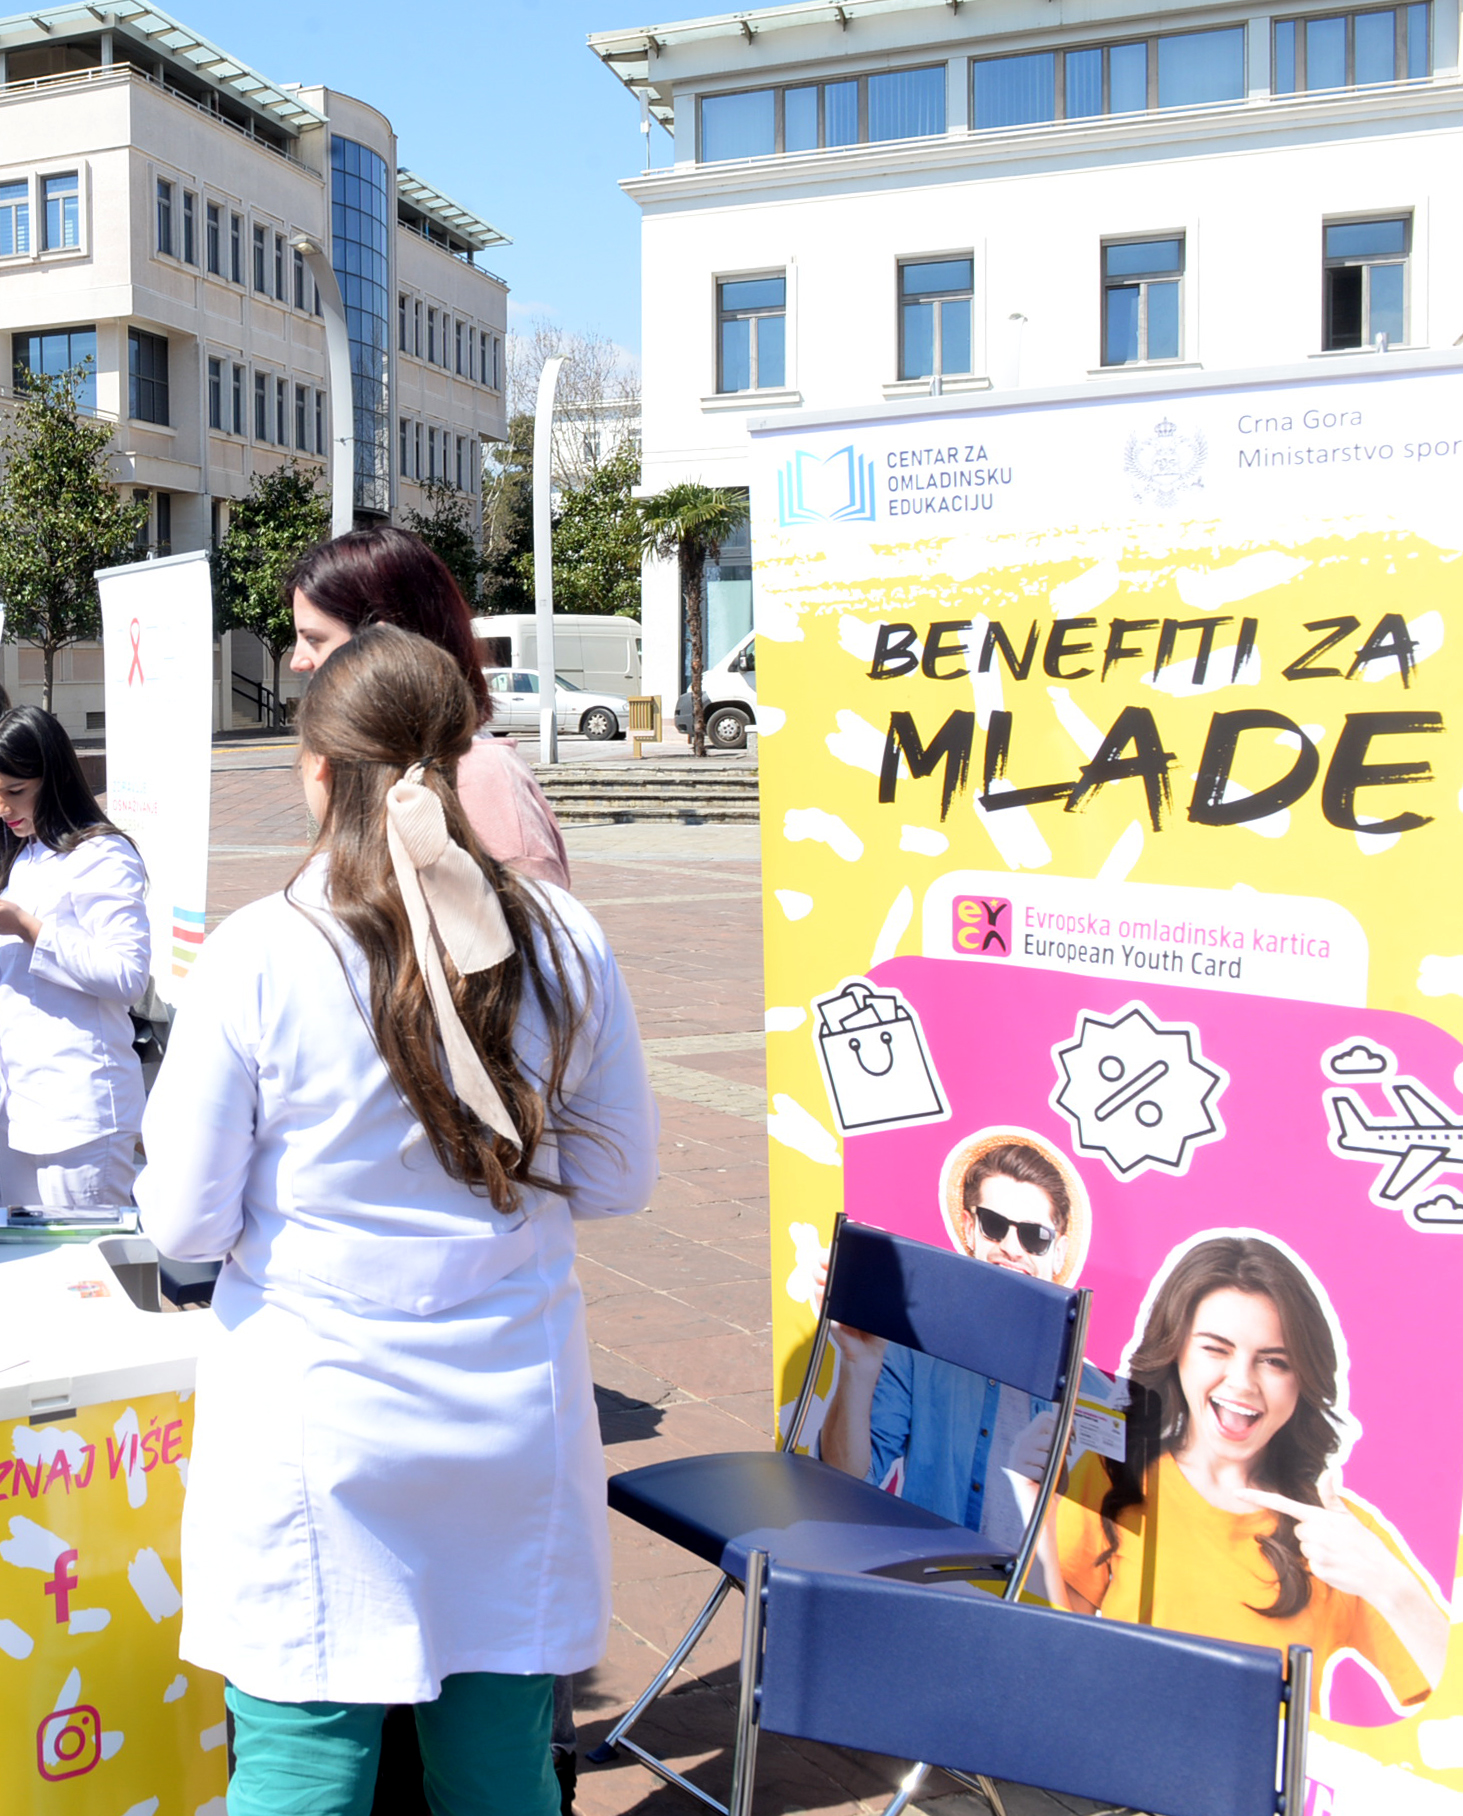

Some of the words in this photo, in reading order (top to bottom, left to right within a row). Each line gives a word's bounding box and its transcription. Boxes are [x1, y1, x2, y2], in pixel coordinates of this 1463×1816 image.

[1238, 415, 1292, 434] Crna
[1303, 409, 1362, 429] Gora
[887, 447, 958, 468] CENTAR
[965, 445, 988, 462] ZA
[1239, 444, 1393, 468] Ministarstvo
[888, 467, 1012, 492] OMLADINSKU
[889, 493, 993, 516] EDUKACIJU
[866, 616, 1258, 685] BENEFITI
[1281, 612, 1419, 689] ZA
[877, 705, 1447, 834] MLADE
[1025, 906, 1110, 936] Evropska
[1118, 918, 1244, 950] omladinska
[1253, 928, 1330, 959] kartica
[1024, 934, 1114, 965] European
[1122, 944, 1183, 973] Youth
[1191, 952, 1242, 979] Card
[105, 1415, 184, 1480] VIŠE
